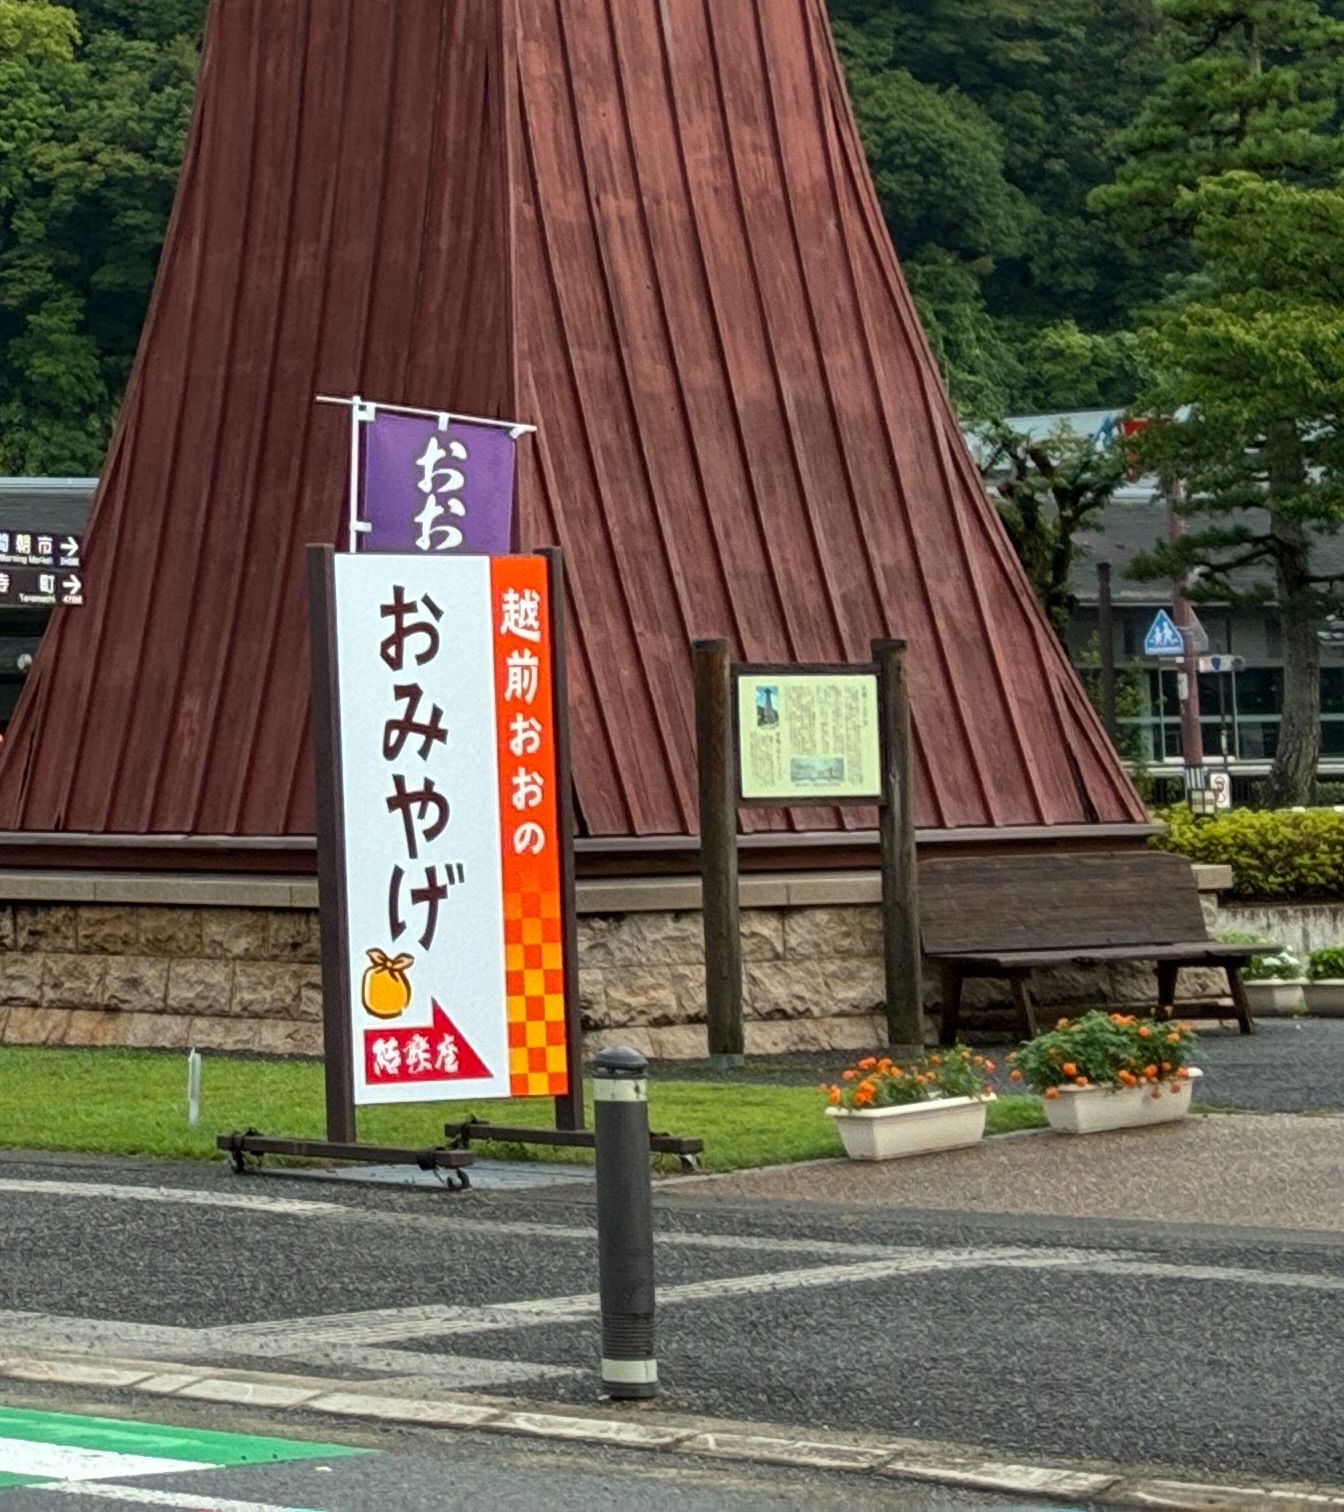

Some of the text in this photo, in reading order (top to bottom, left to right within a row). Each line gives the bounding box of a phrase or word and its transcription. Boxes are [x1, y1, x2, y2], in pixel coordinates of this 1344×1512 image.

[414, 437, 468, 552] おお
[379, 584, 465, 952] おみやげ
[500, 587, 546, 855] 越前おおの
